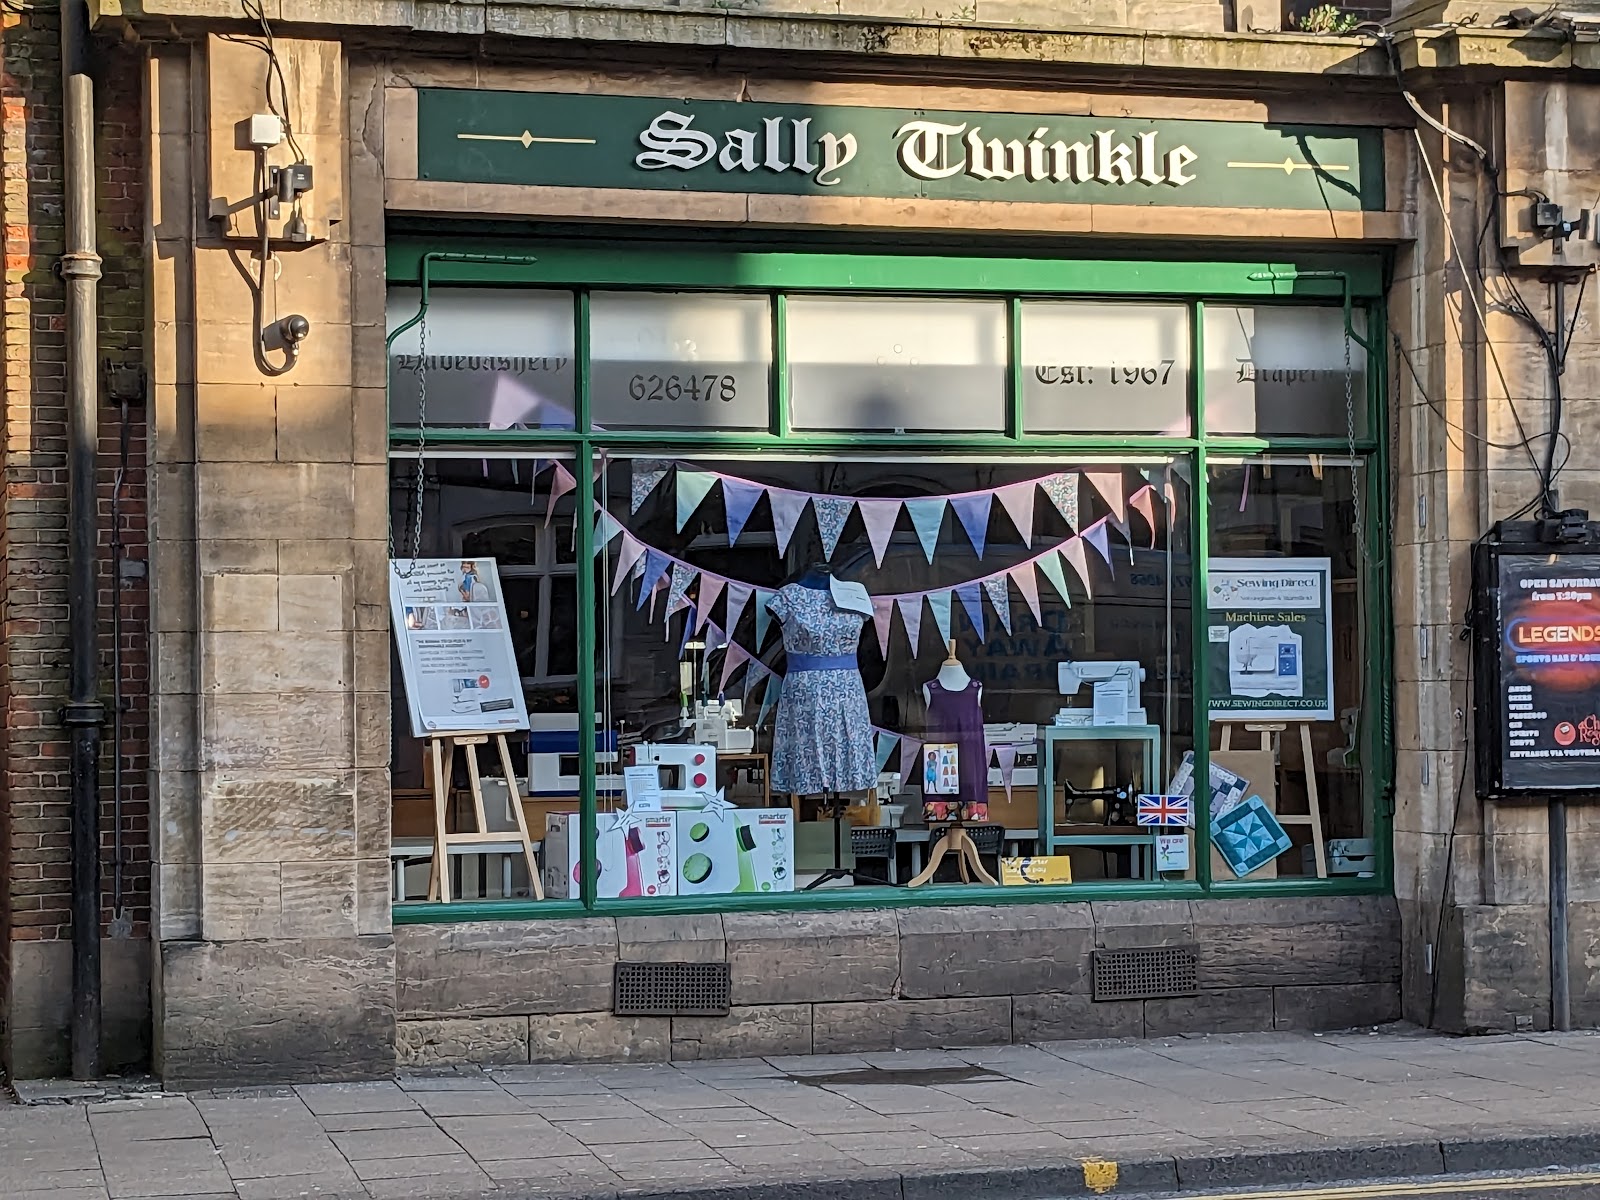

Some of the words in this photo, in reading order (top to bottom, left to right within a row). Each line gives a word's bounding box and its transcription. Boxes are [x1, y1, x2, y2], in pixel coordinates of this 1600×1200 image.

[635, 109, 858, 186] Sally
[892, 120, 1198, 187] Twinkle
[628, 374, 737, 402] 626478
[1237, 578, 1279, 589] Sewing
[1281, 578, 1317, 587] Direct
[1225, 612, 1275, 622] Machine
[1277, 612, 1307, 622] Sales
[1518, 625, 1600, 643] LEGENDS
[758, 812, 787, 820] smarter
